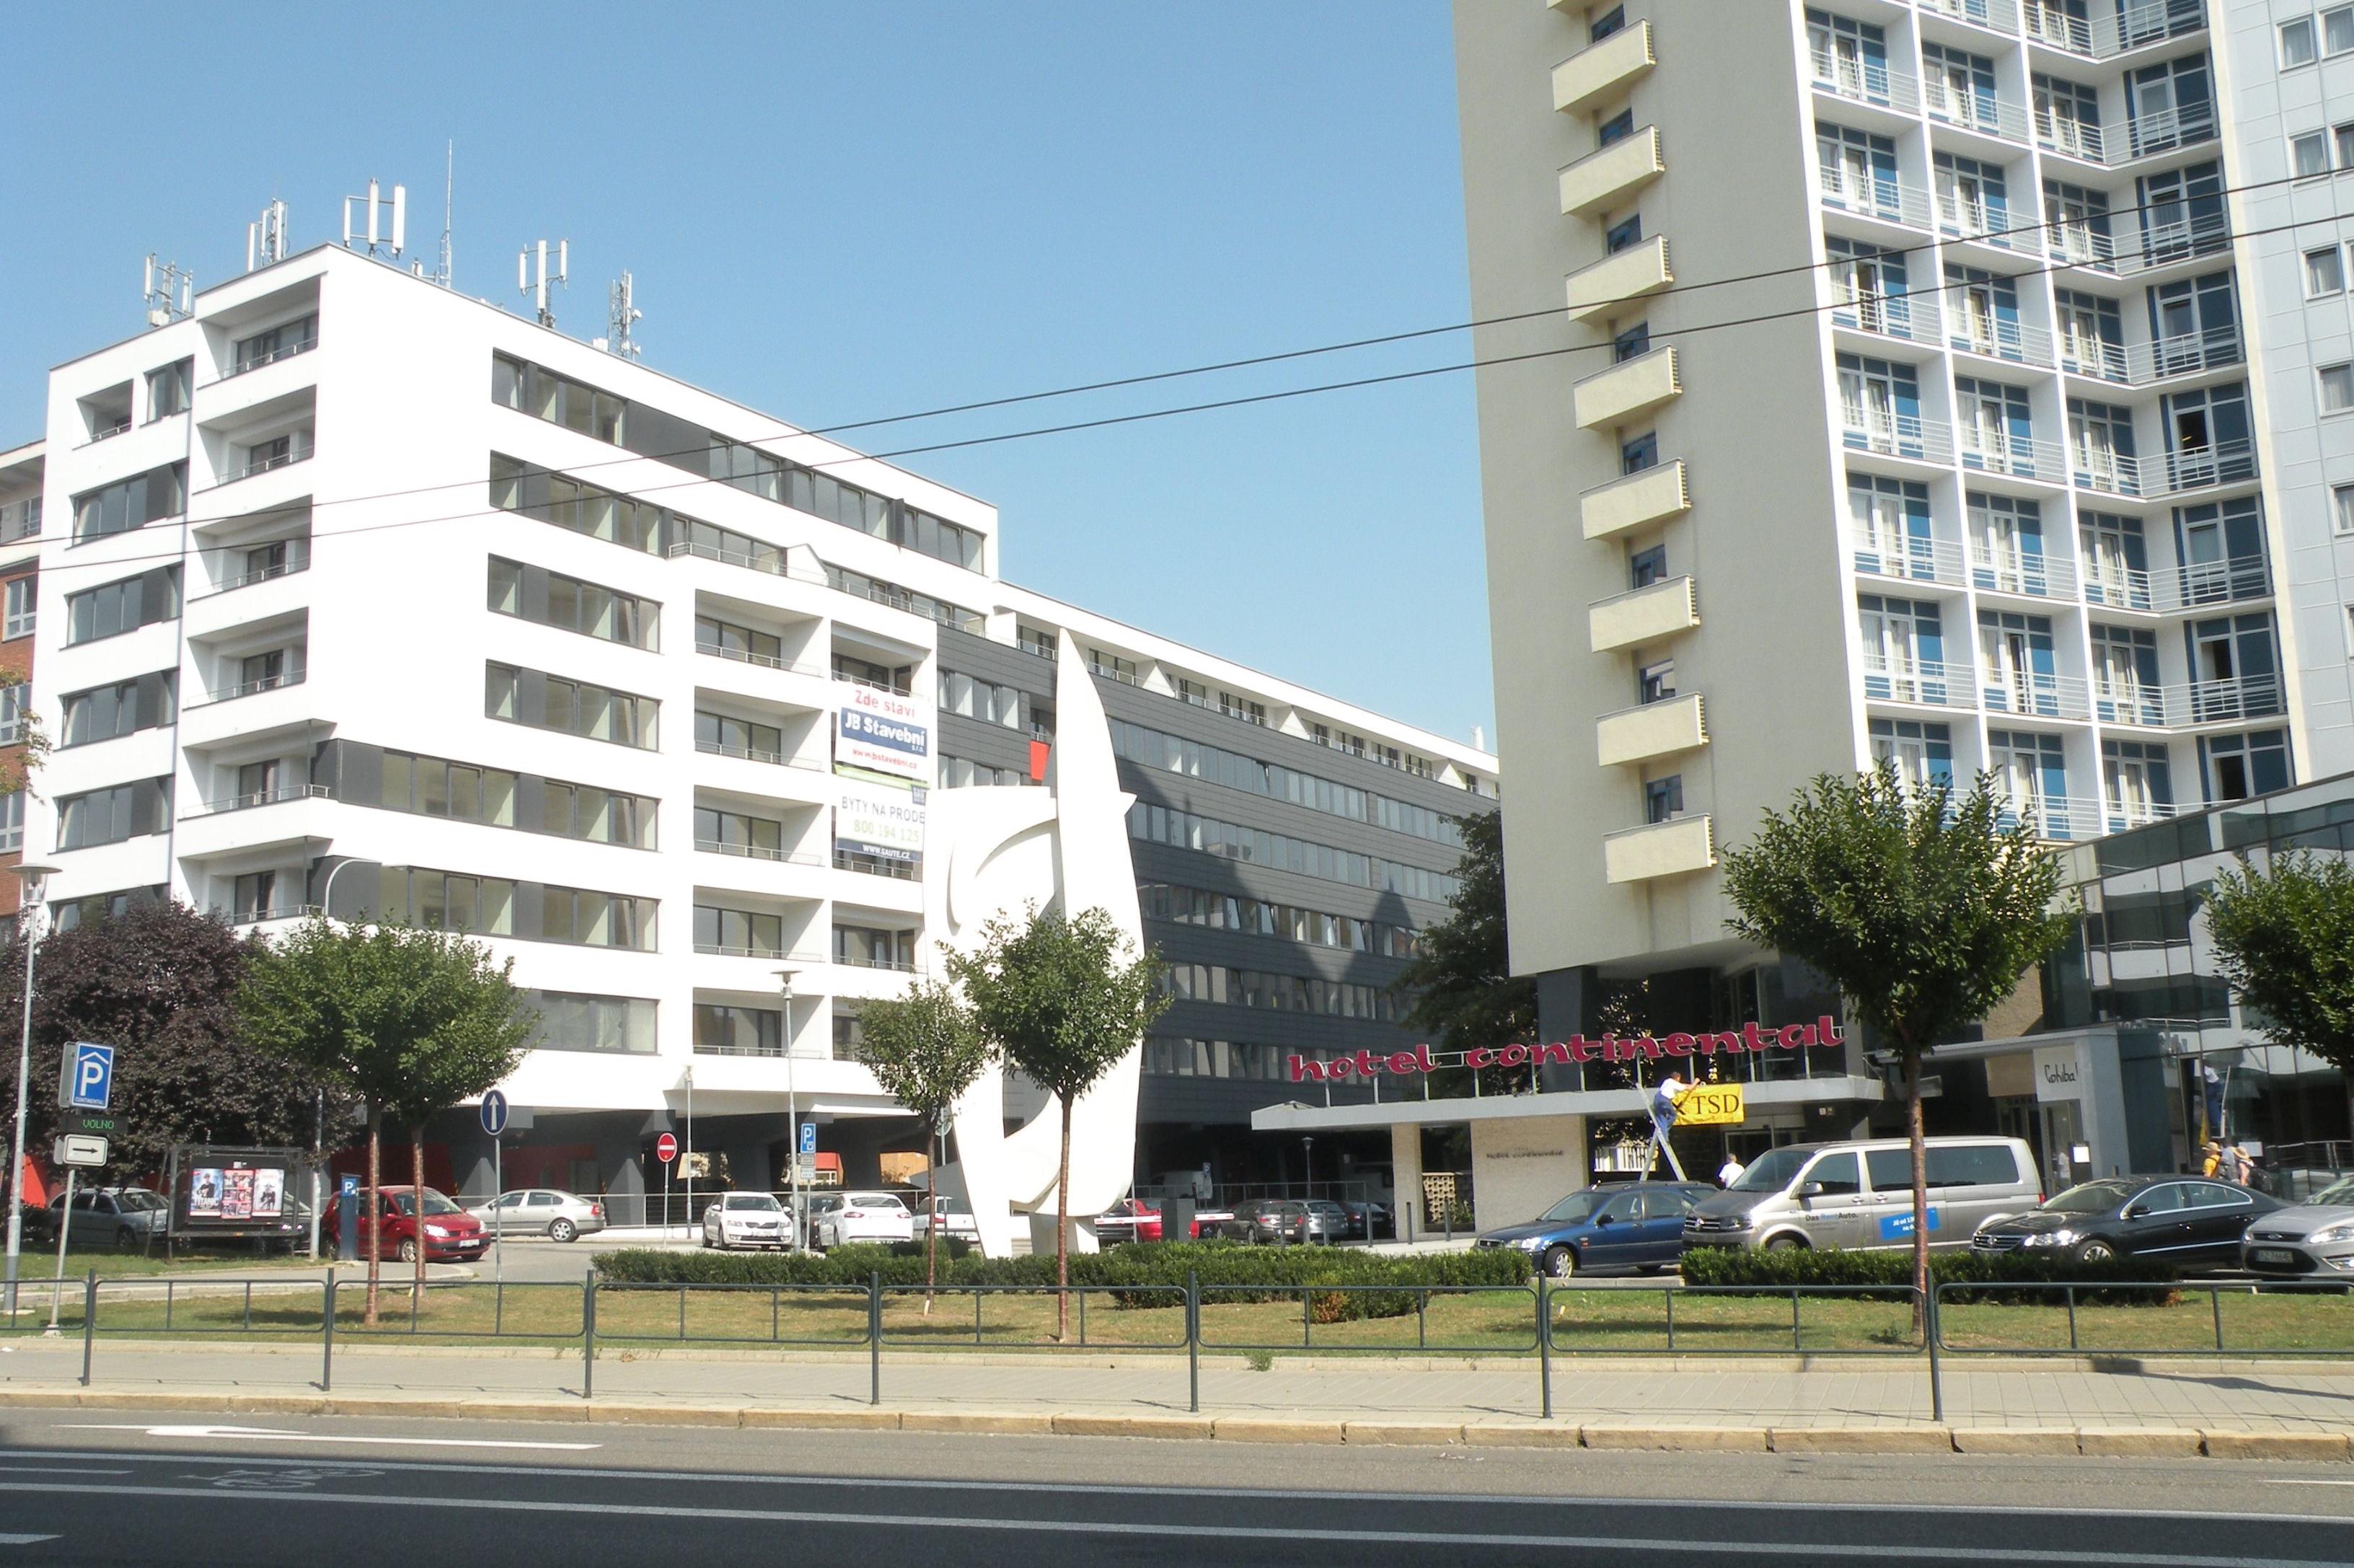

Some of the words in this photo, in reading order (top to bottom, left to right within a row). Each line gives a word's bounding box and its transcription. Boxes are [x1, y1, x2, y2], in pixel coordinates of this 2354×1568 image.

[855, 690, 878, 708] Zde
[845, 712, 861, 731] JB
[863, 716, 925, 746] Stavební
[842, 796, 868, 813] BYTY
[872, 802, 886, 816] NA
[854, 819, 874, 835] 800
[901, 828, 919, 842] 125
[1287, 1044, 1442, 1082] hotel
[1465, 1015, 1848, 1069] continental
[80, 1060, 104, 1096] P
[803, 1127, 813, 1144] P
[344, 1181, 353, 1193] P
